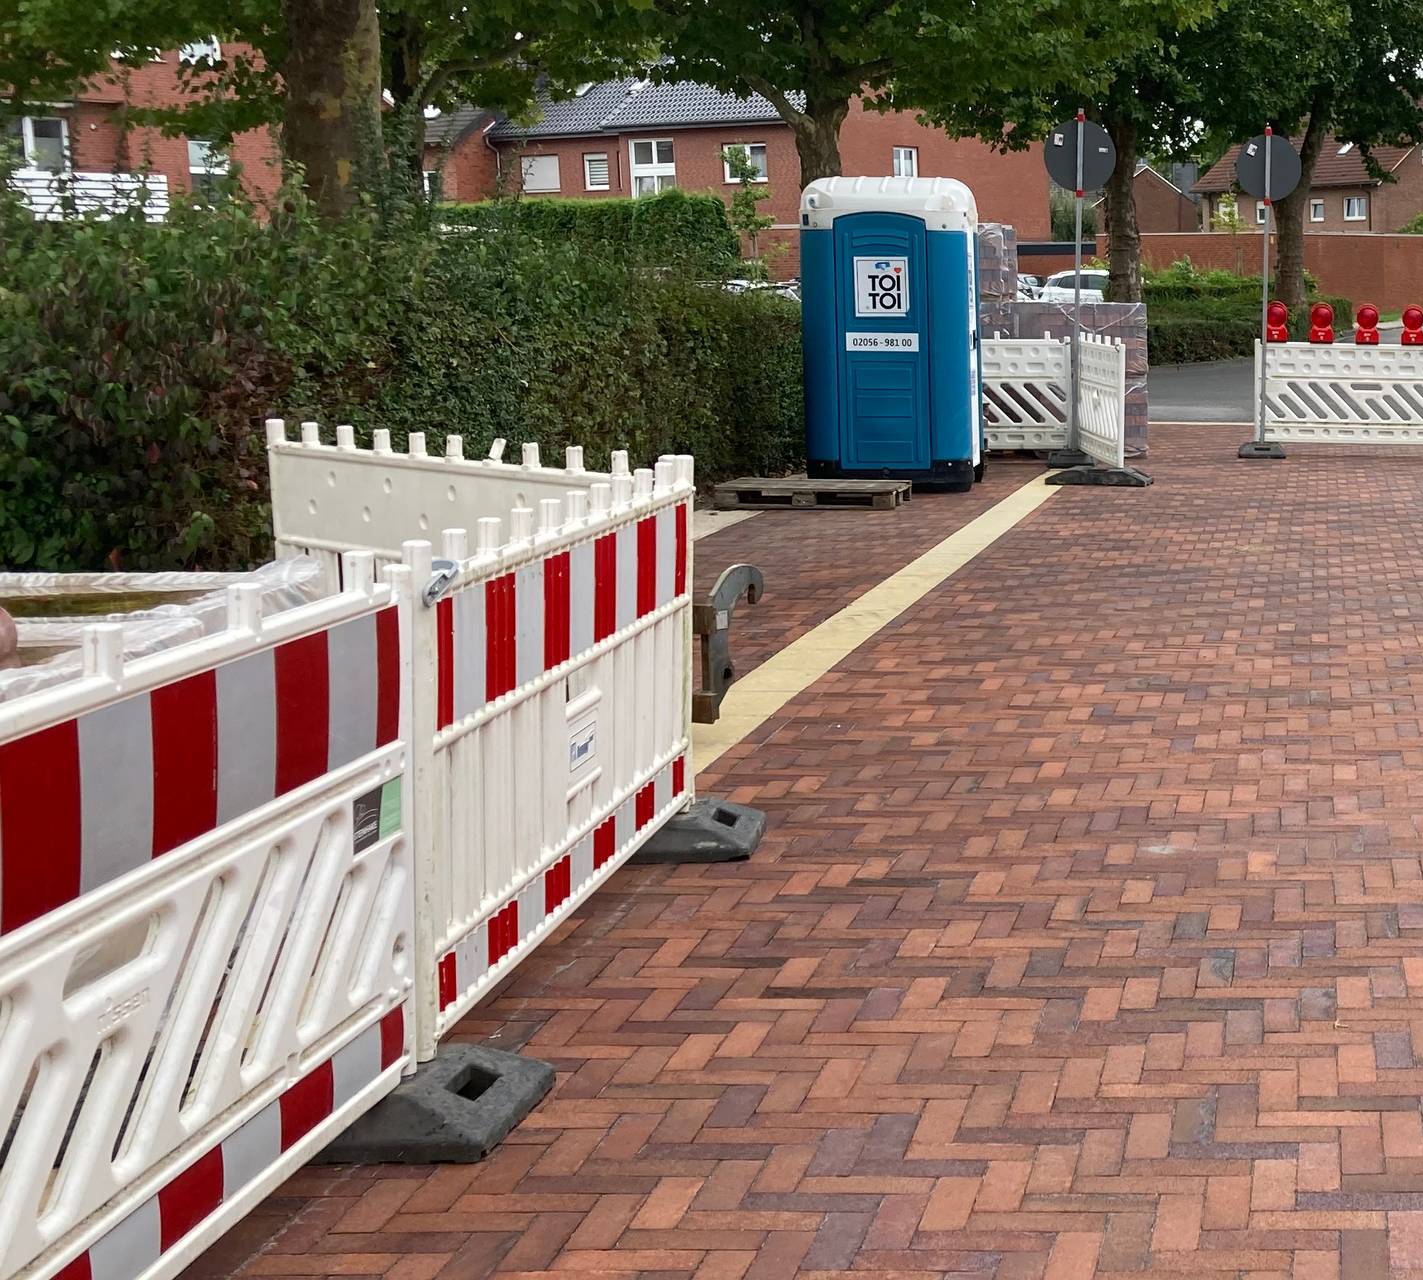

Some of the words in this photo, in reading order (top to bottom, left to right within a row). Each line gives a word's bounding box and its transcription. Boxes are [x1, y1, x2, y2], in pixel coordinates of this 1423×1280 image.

[868, 293, 902, 309] TOI
[852, 338, 878, 347] 02056
[884, 338, 899, 347] 981
[901, 339, 912, 347] 00
